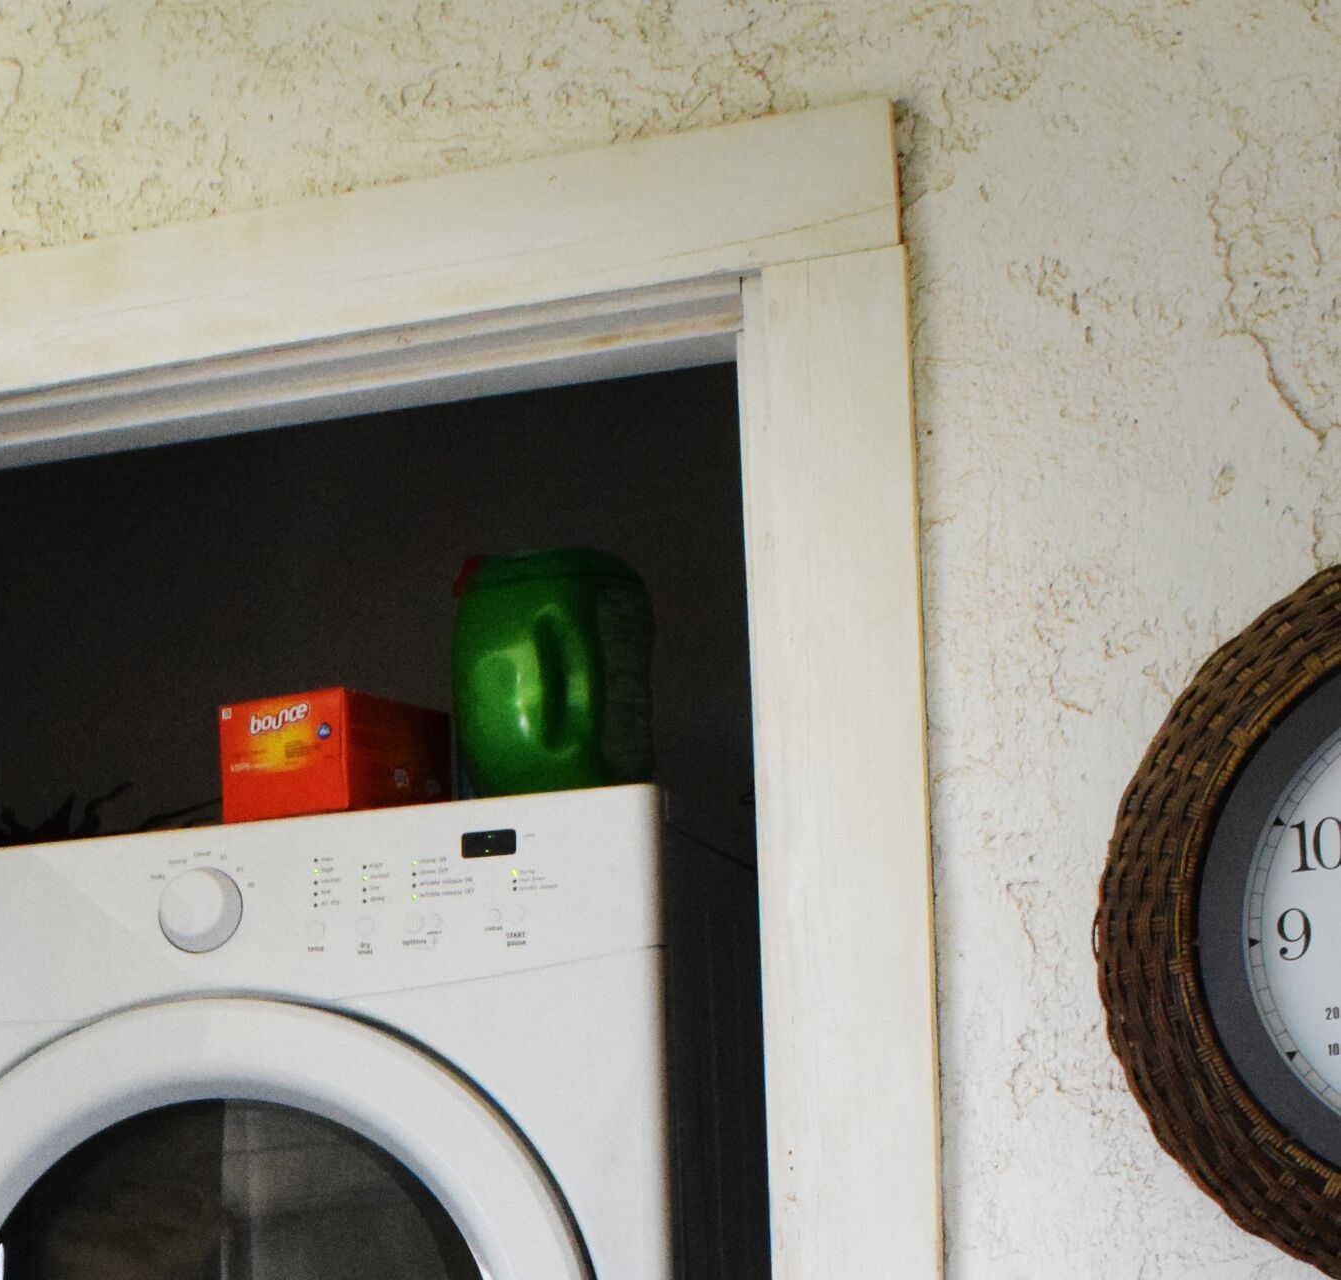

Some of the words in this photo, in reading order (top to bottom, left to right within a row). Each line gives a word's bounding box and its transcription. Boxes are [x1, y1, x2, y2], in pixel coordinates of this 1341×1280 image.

[249, 702, 309, 735] bounce
[1289, 816, 1341, 873] 10
[1277, 908, 1311, 961] 9
[1325, 1006, 1340, 1020] 20
